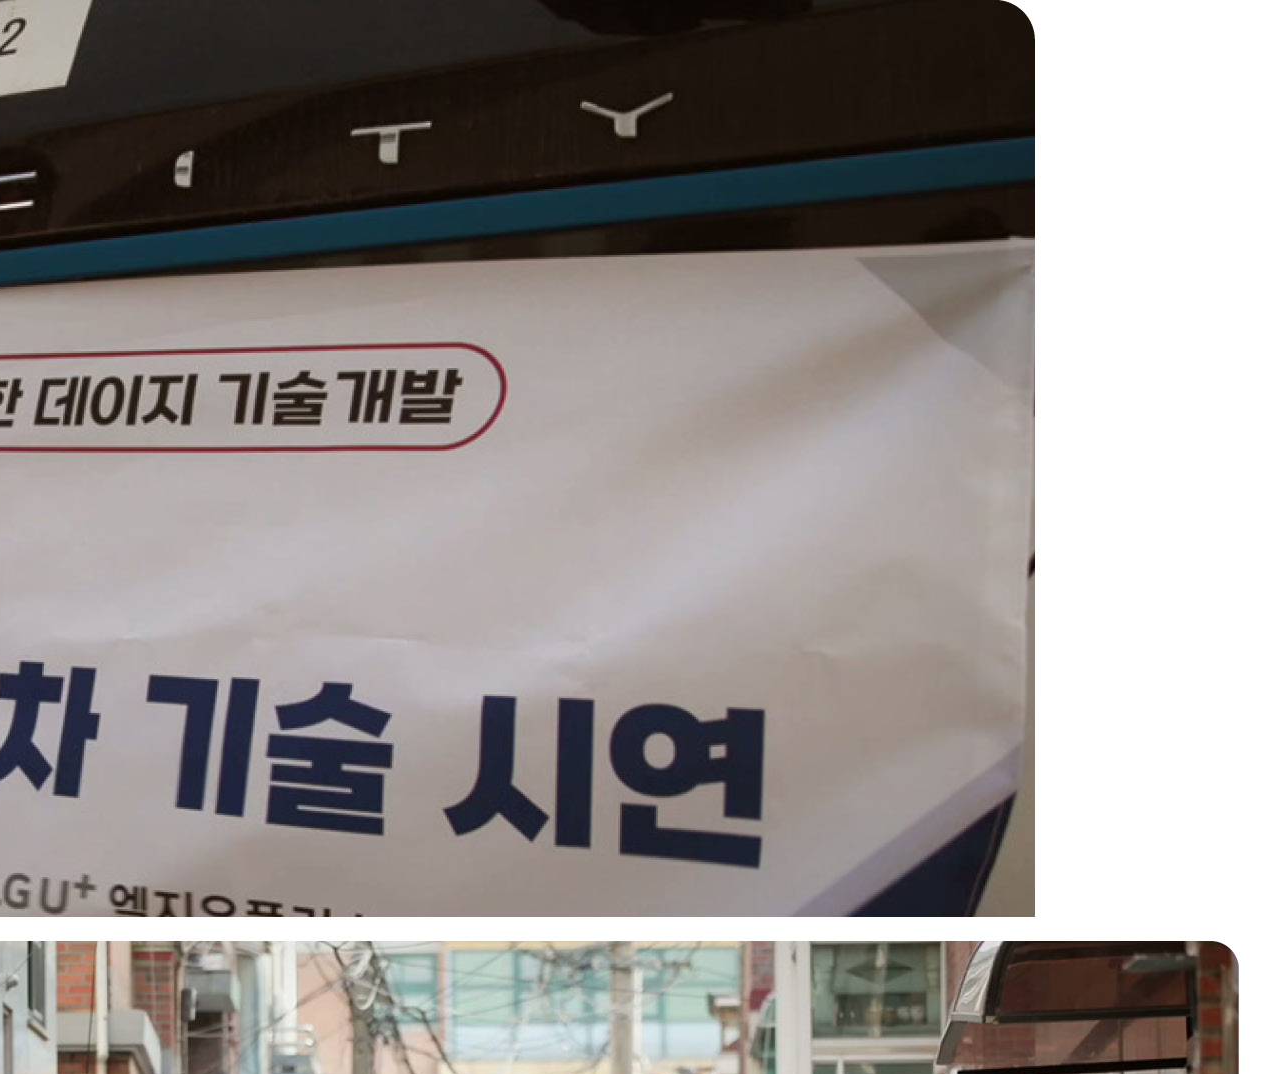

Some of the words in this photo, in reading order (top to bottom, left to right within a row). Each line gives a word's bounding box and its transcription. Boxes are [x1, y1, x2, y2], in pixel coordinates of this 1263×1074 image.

[33, 373, 199, 427] 데이지
[145, 673, 394, 837] 기술
[442, 694, 766, 869] 시연
